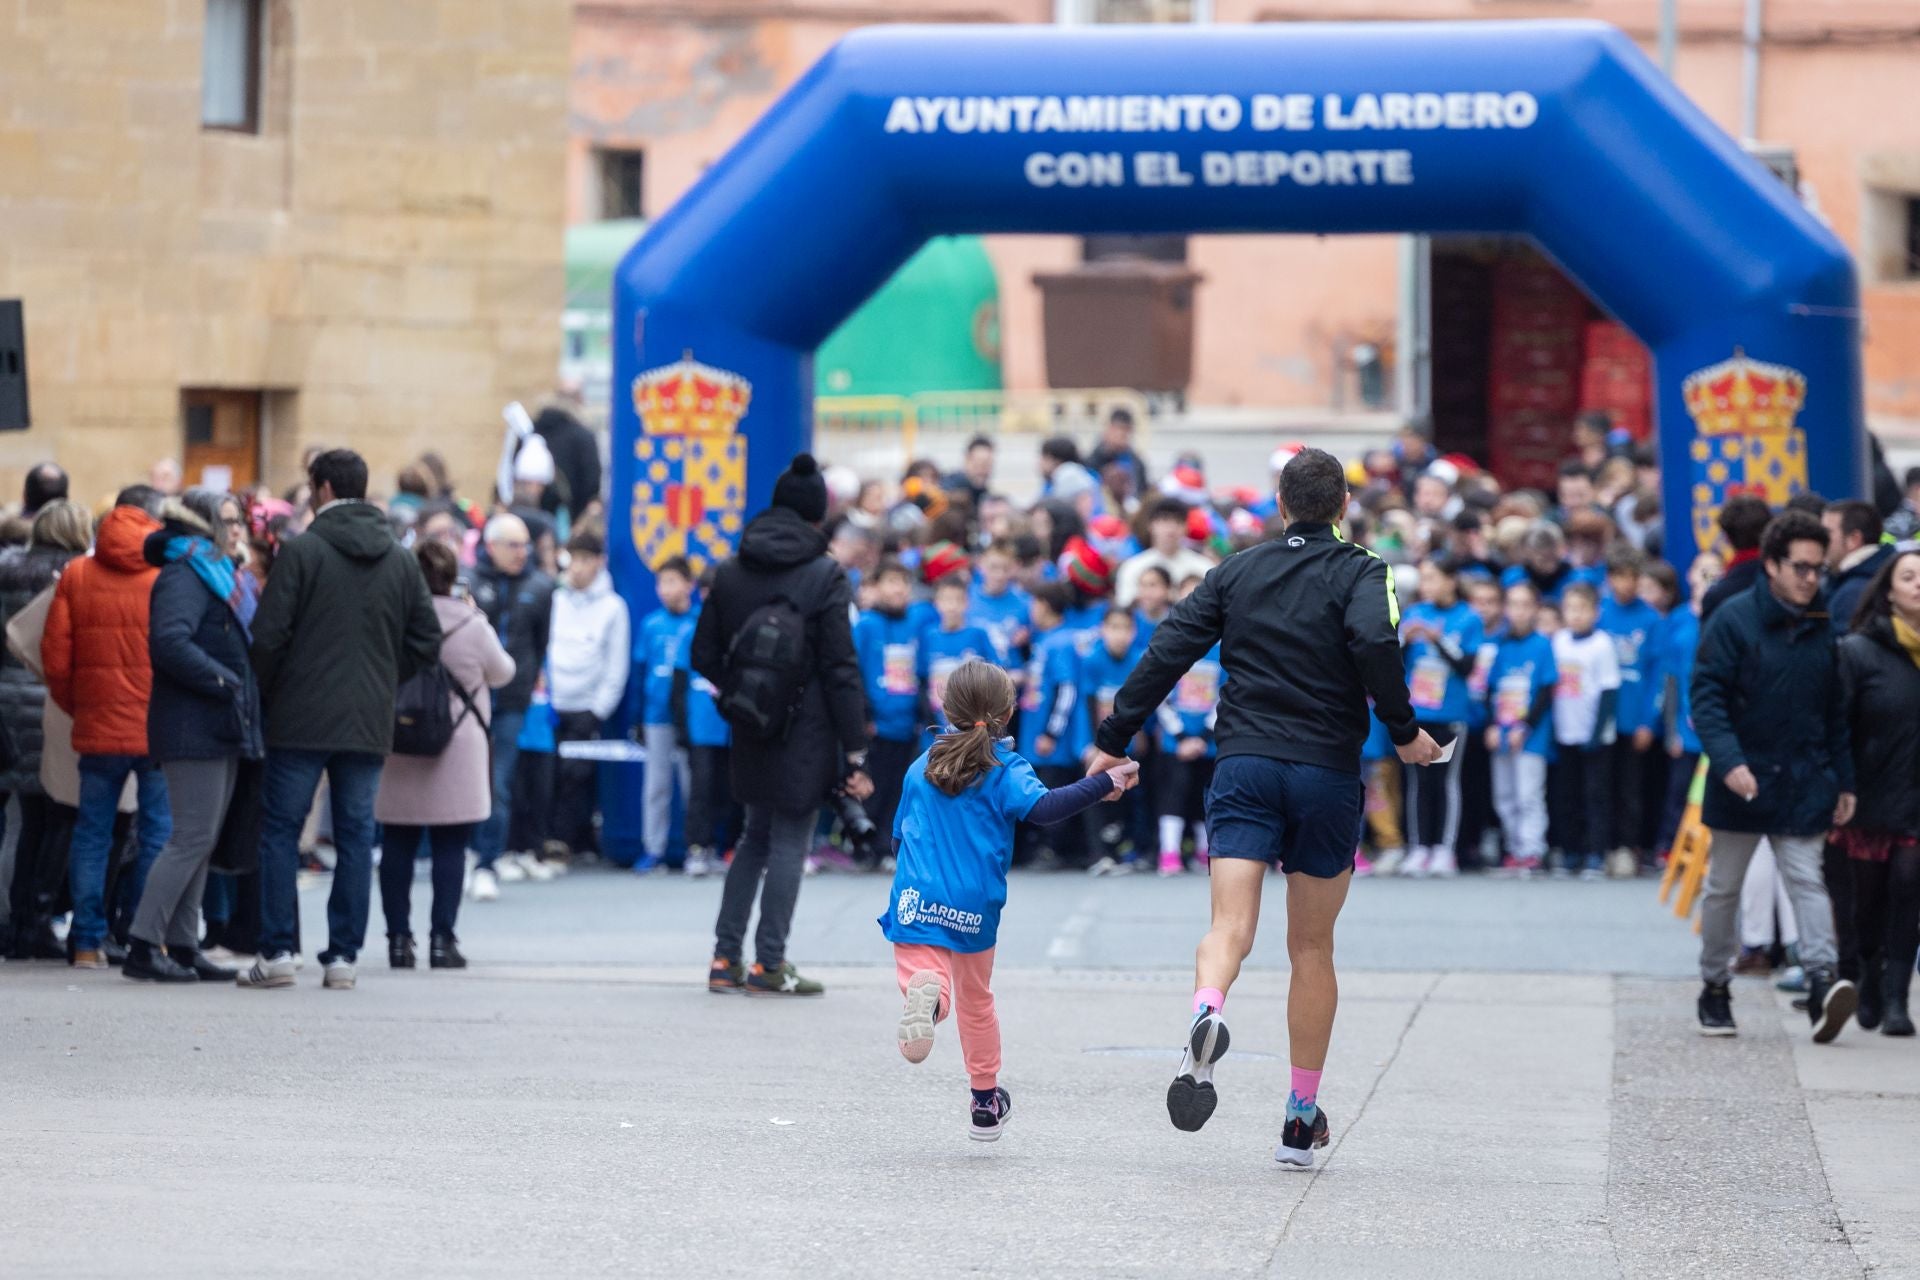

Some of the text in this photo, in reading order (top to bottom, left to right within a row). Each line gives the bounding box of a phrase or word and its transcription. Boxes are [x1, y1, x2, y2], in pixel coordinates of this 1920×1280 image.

[885, 91, 1539, 133] AYUNTAMIENTO DE LARDERO
[1025, 150, 1413, 187] CON EL DEPORTE
[915, 912, 980, 934] ayuntamiento
[919, 900, 982, 926] LARDERO
